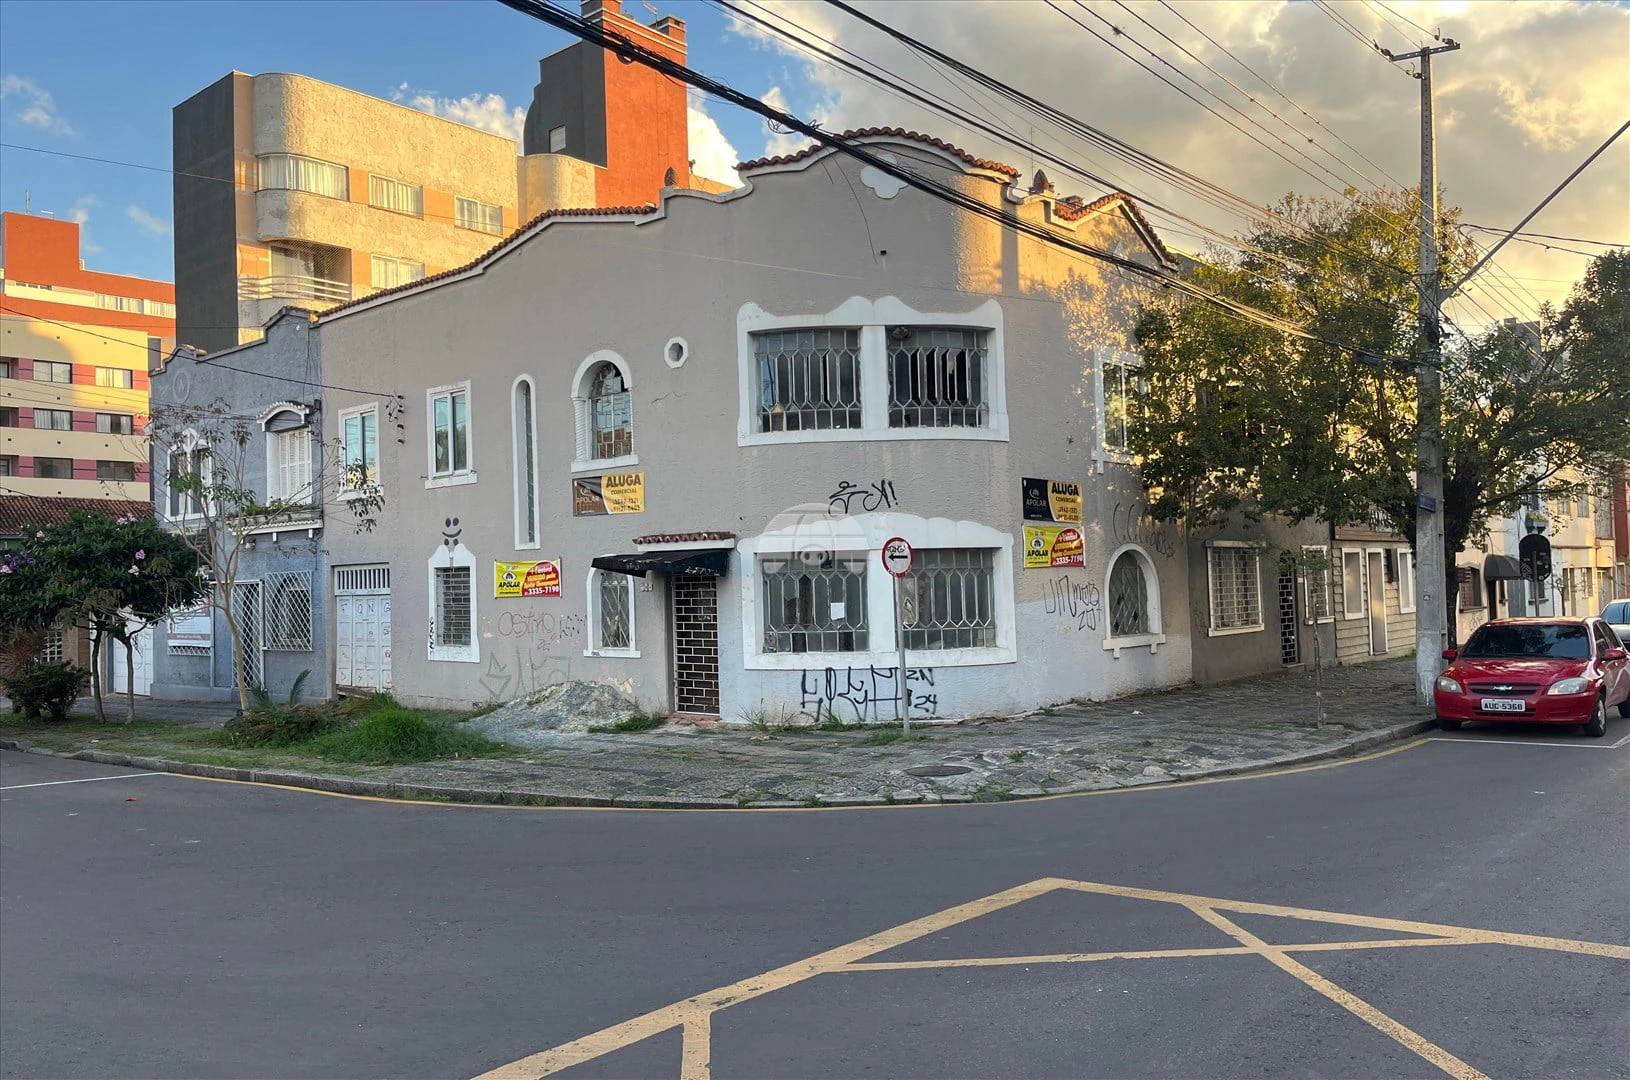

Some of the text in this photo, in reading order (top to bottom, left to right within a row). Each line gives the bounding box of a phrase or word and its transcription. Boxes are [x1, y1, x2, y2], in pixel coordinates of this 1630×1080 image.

[606, 475, 641, 488] ALUGA
[1051, 483, 1079, 496] ALUGA
[1026, 499, 1047, 507] APOLAR
